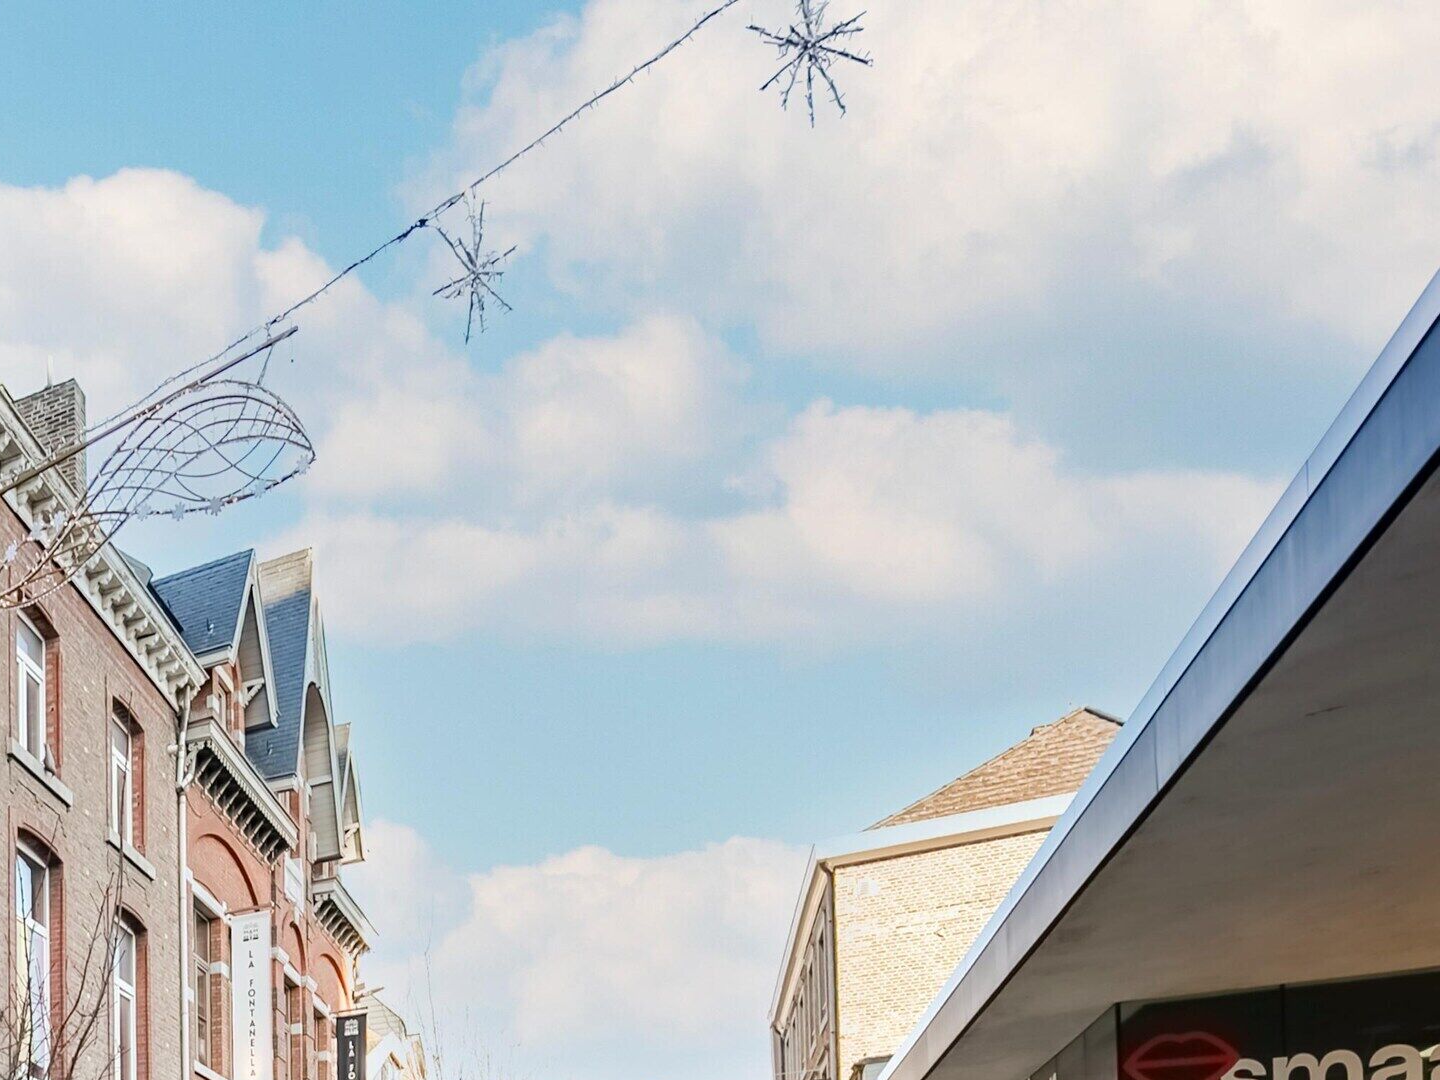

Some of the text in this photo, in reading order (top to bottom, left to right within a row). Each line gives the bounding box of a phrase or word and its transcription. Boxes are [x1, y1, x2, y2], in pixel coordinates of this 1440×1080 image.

[248, 951, 256, 1076] LA FONTANELLA
[348, 1040, 355, 1057] LA
